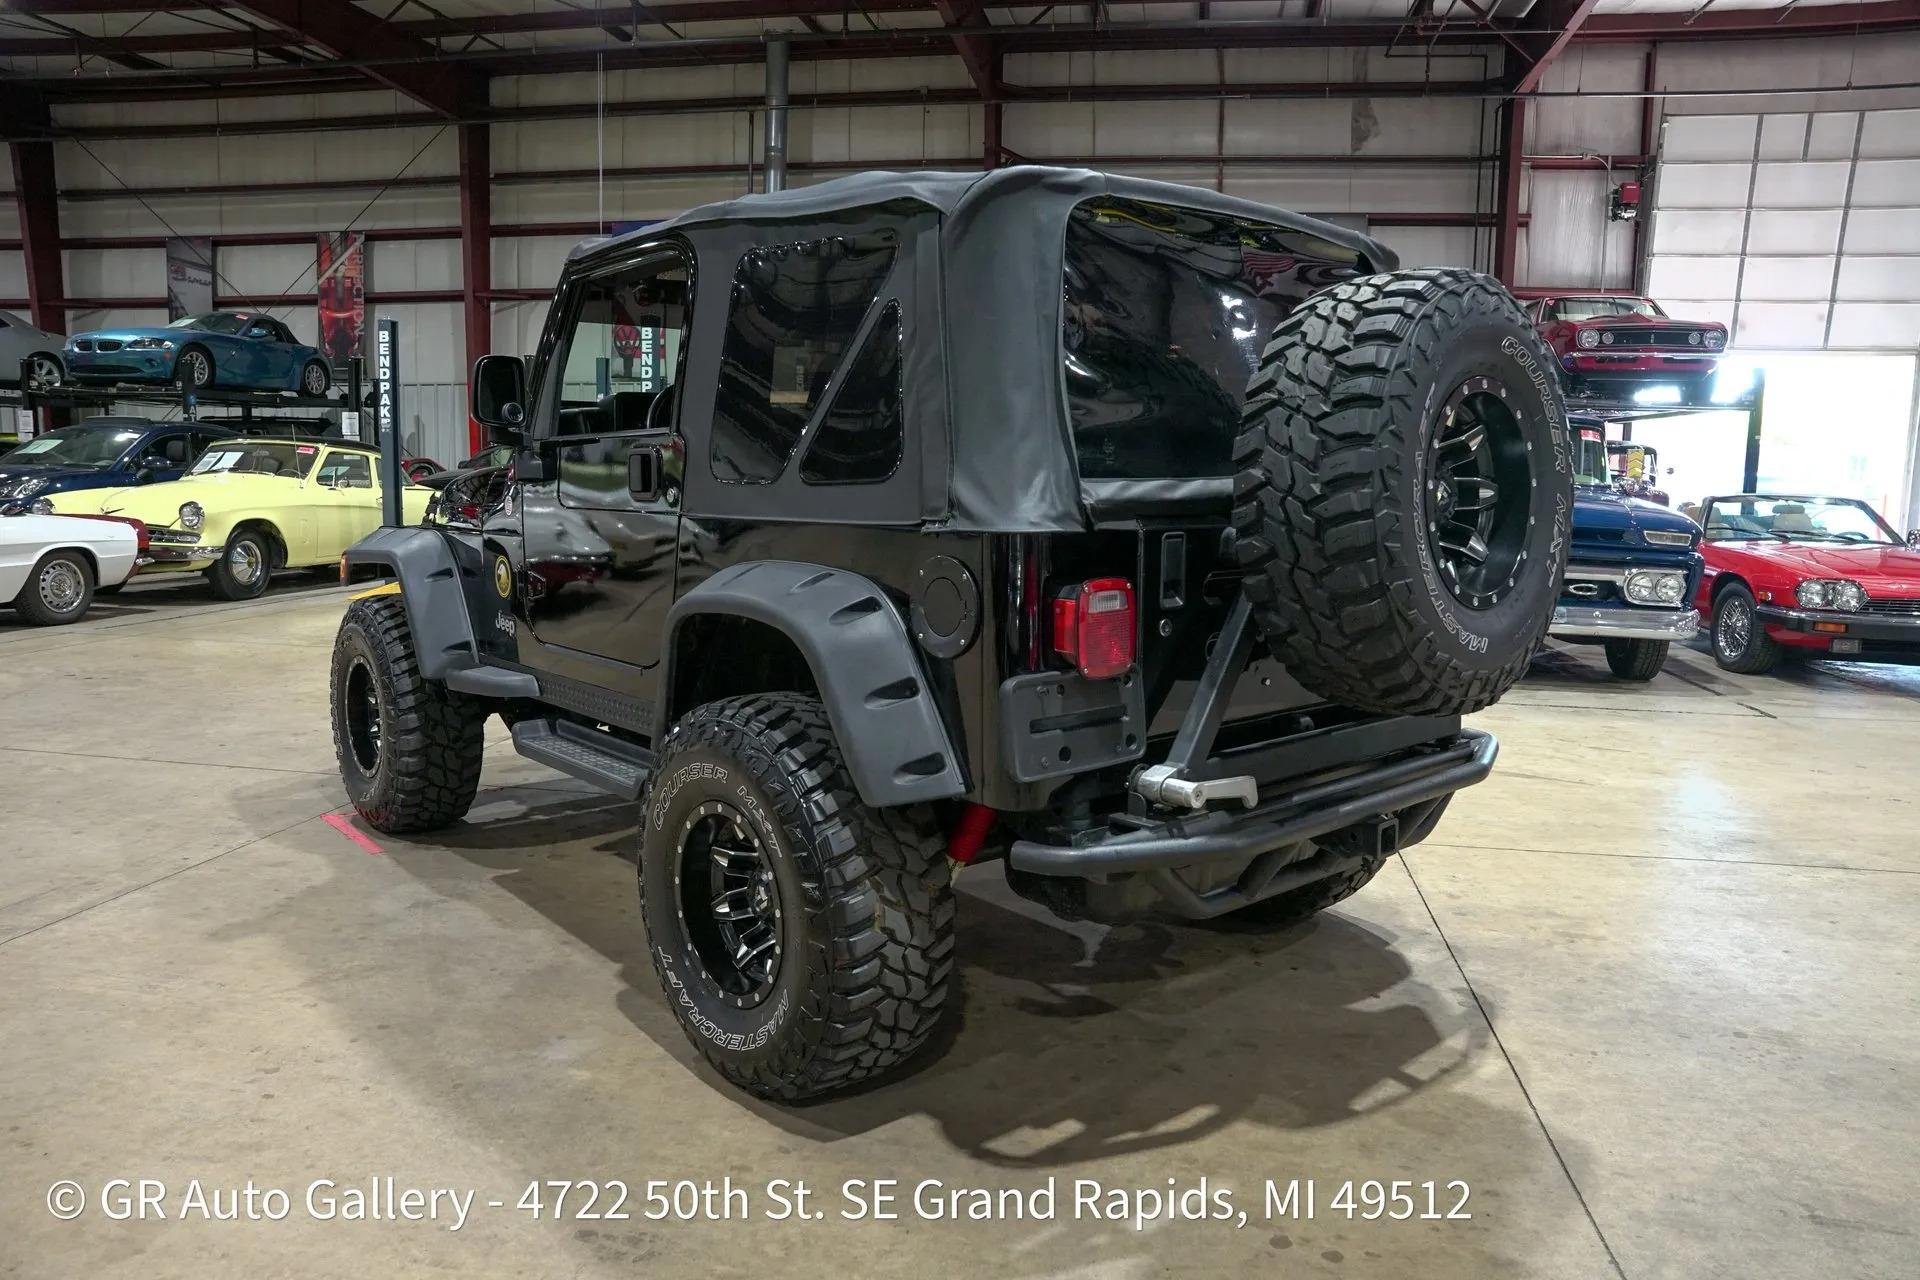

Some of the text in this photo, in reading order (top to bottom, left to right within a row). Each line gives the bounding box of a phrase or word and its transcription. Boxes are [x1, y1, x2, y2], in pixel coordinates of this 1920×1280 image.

[378, 330, 391, 418] BENDPAK
[1500, 335, 1568, 588] COURSER MXT
[1412, 382, 1489, 654] MASTERCRAFT
[495, 610, 516, 637] Jeep
[653, 761, 783, 859] COURSER MXT
[656, 945, 791, 1053] MASTERCRAFT
